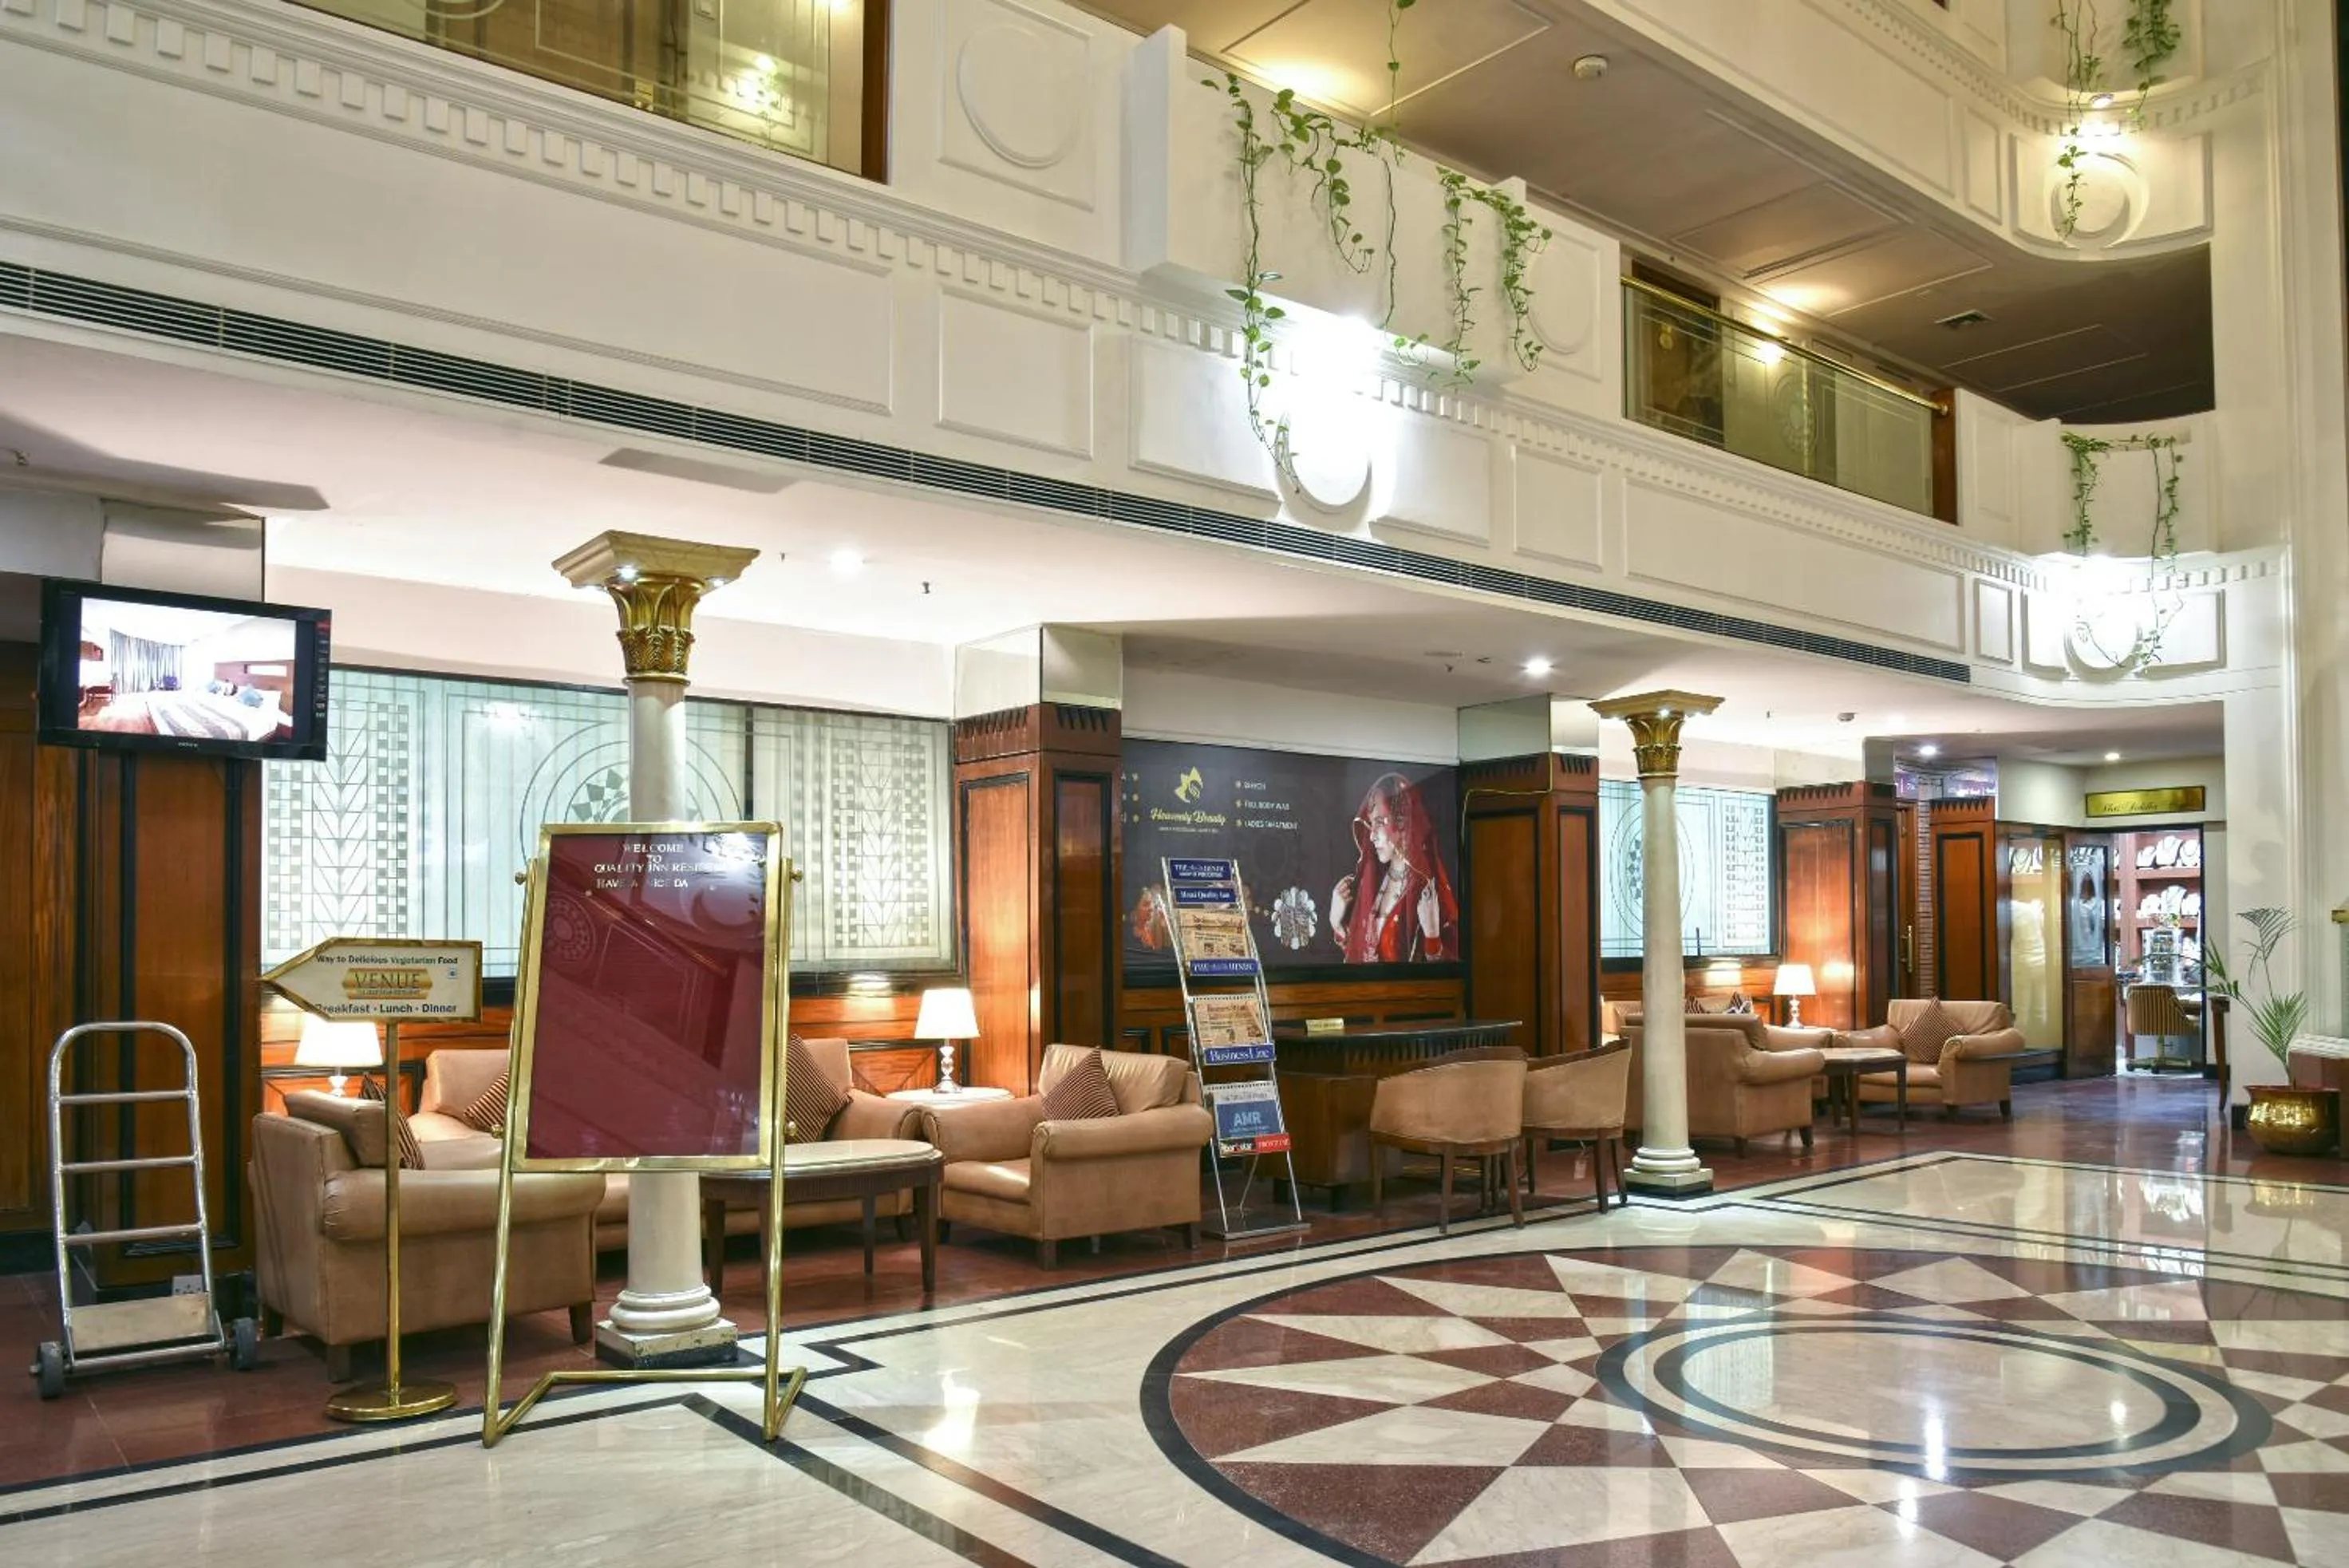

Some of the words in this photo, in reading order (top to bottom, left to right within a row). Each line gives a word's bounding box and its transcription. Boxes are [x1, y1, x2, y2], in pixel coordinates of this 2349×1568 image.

[646, 855, 662, 864] TO
[594, 863, 644, 873] QUALITY
[349, 955, 389, 964] Delicious
[355, 972, 420, 989] VENUE
[380, 1004, 413, 1013] Lunch
[422, 1004, 457, 1013] Dinner
